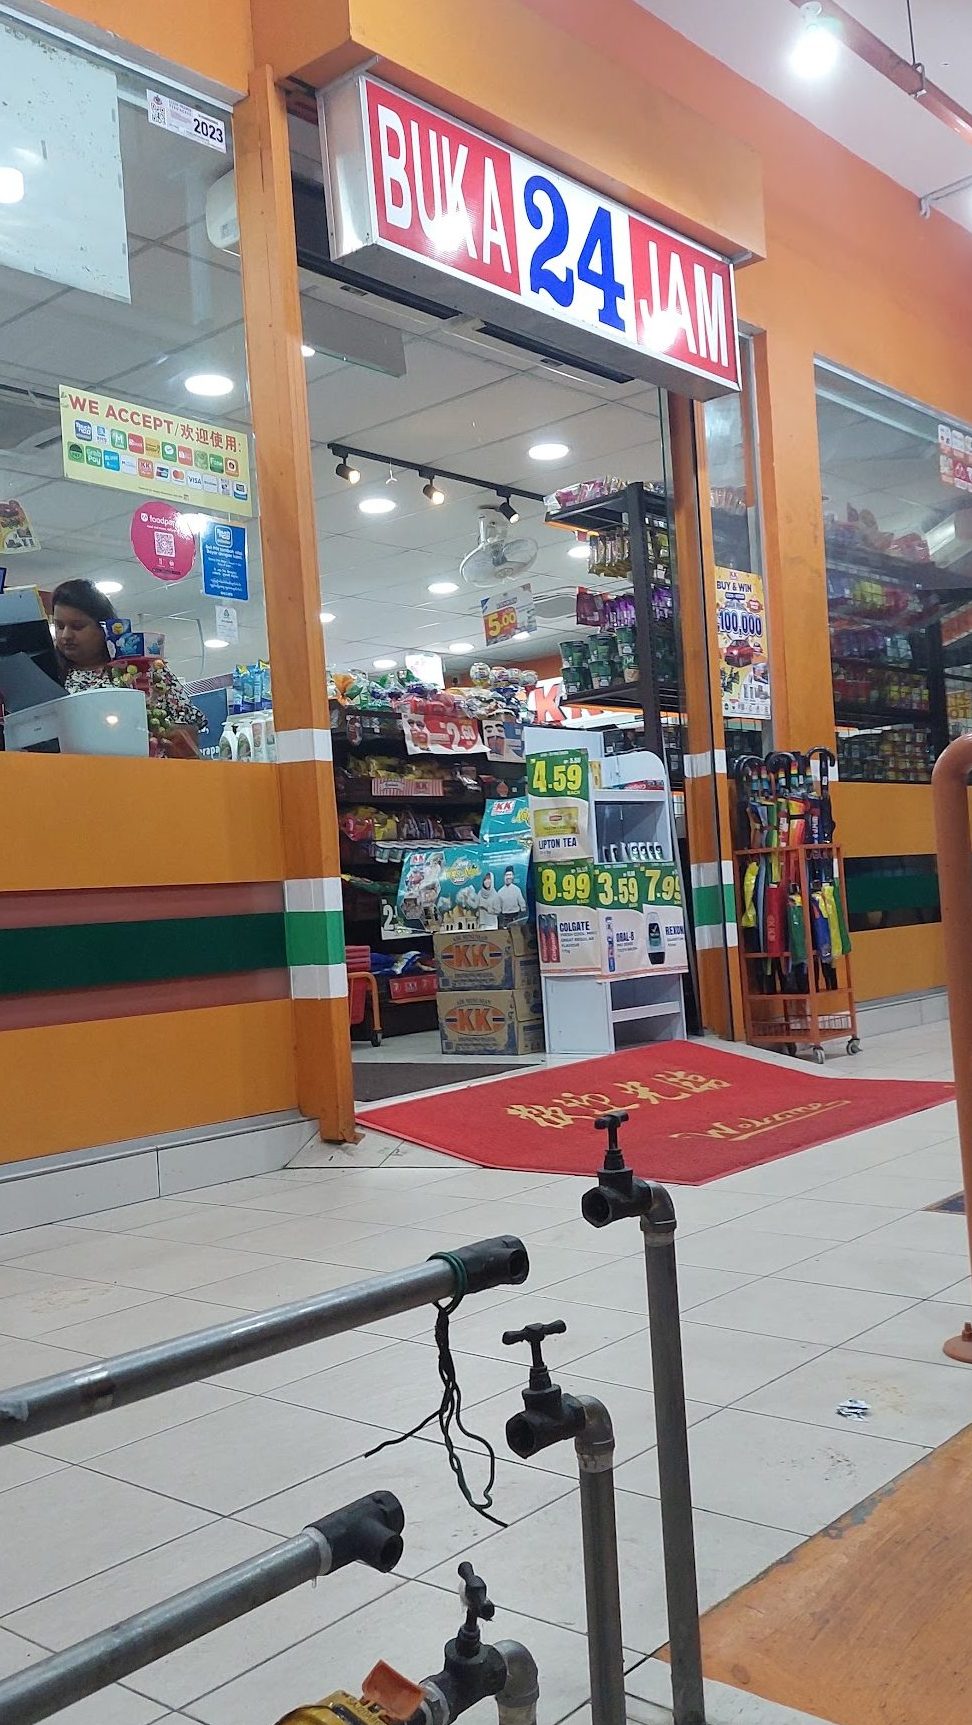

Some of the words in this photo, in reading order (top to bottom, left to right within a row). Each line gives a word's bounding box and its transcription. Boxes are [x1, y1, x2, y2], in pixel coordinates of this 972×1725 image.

[193, 118, 224, 143] 2023
[377, 103, 512, 274] BUKA
[523, 175, 626, 332] 24
[637, 240, 729, 368] JAM
[68, 393, 100, 417] WE
[188, 476, 201, 485] VISA
[716, 580, 731, 591] BUY
[738, 583, 752, 593] WIN
[488, 612, 516, 637] 5.00
[532, 760, 583, 793] 4.59
[538, 838, 561, 850] LIPTON
[562, 837, 577, 848] TEA
[541, 868, 591, 902] 8.99
[597, 872, 639, 906] 3.59
[559, 920, 591, 933] COLGATE
[615, 931, 635, 943] ORAL-B
[454, 943, 489, 968] KK
[457, 1008, 493, 1032] KK
[668, 1100, 852, 1142] Welcome
